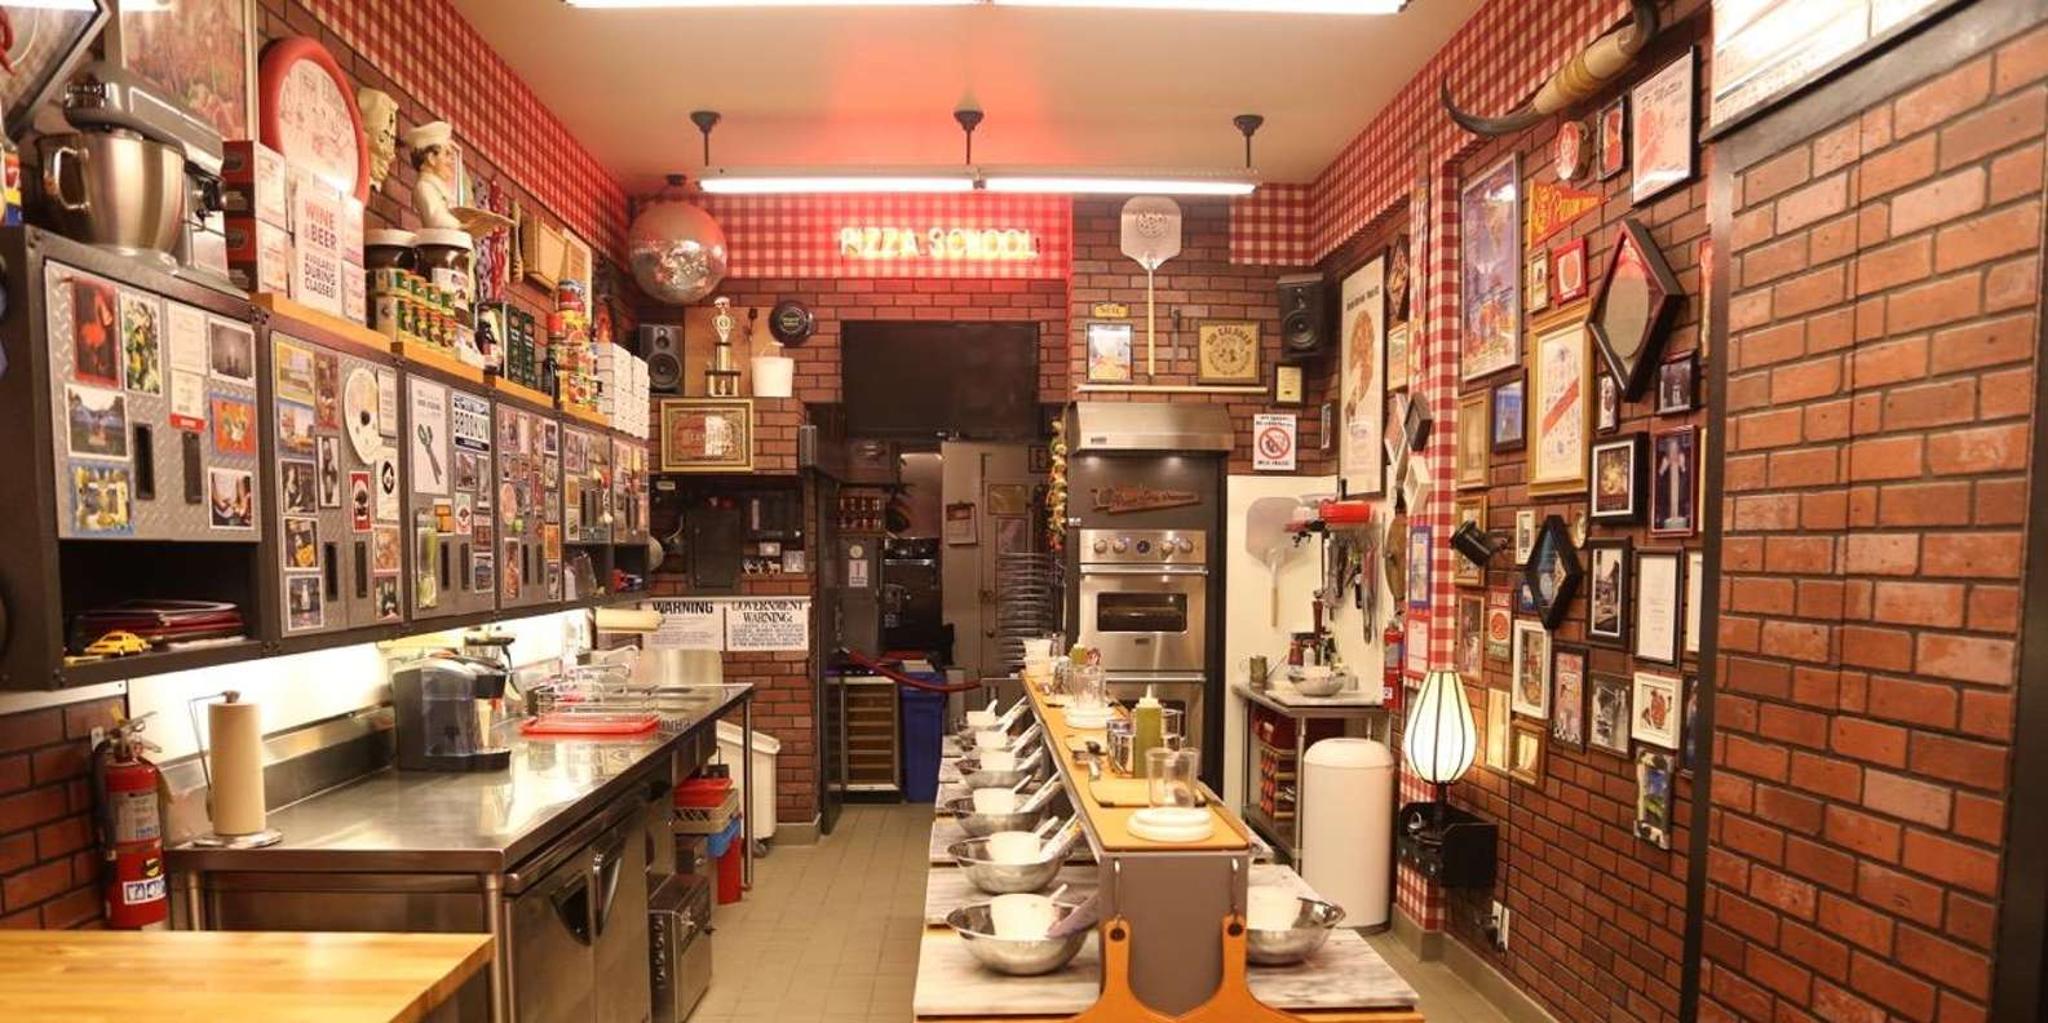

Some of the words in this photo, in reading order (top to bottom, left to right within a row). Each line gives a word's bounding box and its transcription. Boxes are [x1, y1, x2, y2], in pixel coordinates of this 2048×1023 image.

[304, 200, 335, 231] WINE
[311, 222, 337, 250] BEER
[840, 226, 921, 259] PIZZA
[928, 226, 1040, 260] SCHOOL
[304, 262, 336, 286] DURING
[653, 600, 713, 615] WARNING
[732, 600, 804, 611] GOVERNMENT
